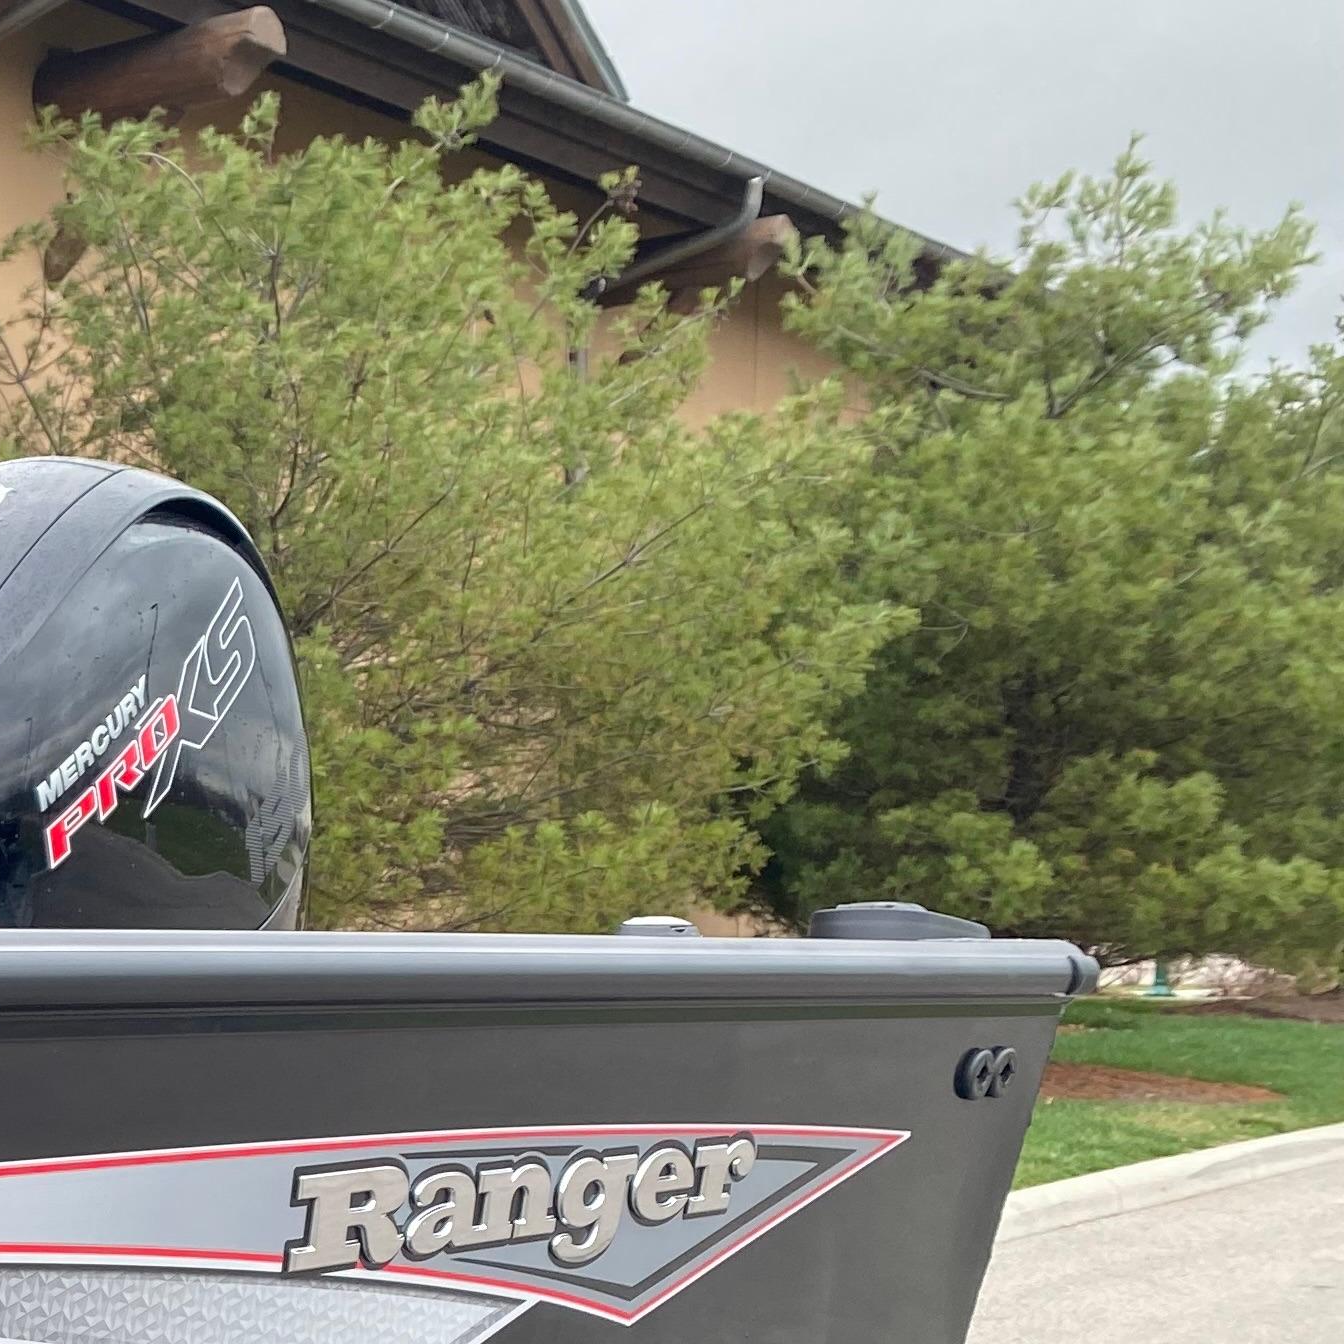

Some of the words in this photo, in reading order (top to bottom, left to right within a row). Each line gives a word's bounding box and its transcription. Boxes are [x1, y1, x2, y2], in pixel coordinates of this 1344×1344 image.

[35, 674, 148, 812] MERCURY
[45, 694, 180, 870] PRO
[143, 576, 257, 818] XS
[282, 1132, 757, 1273] Ranger
